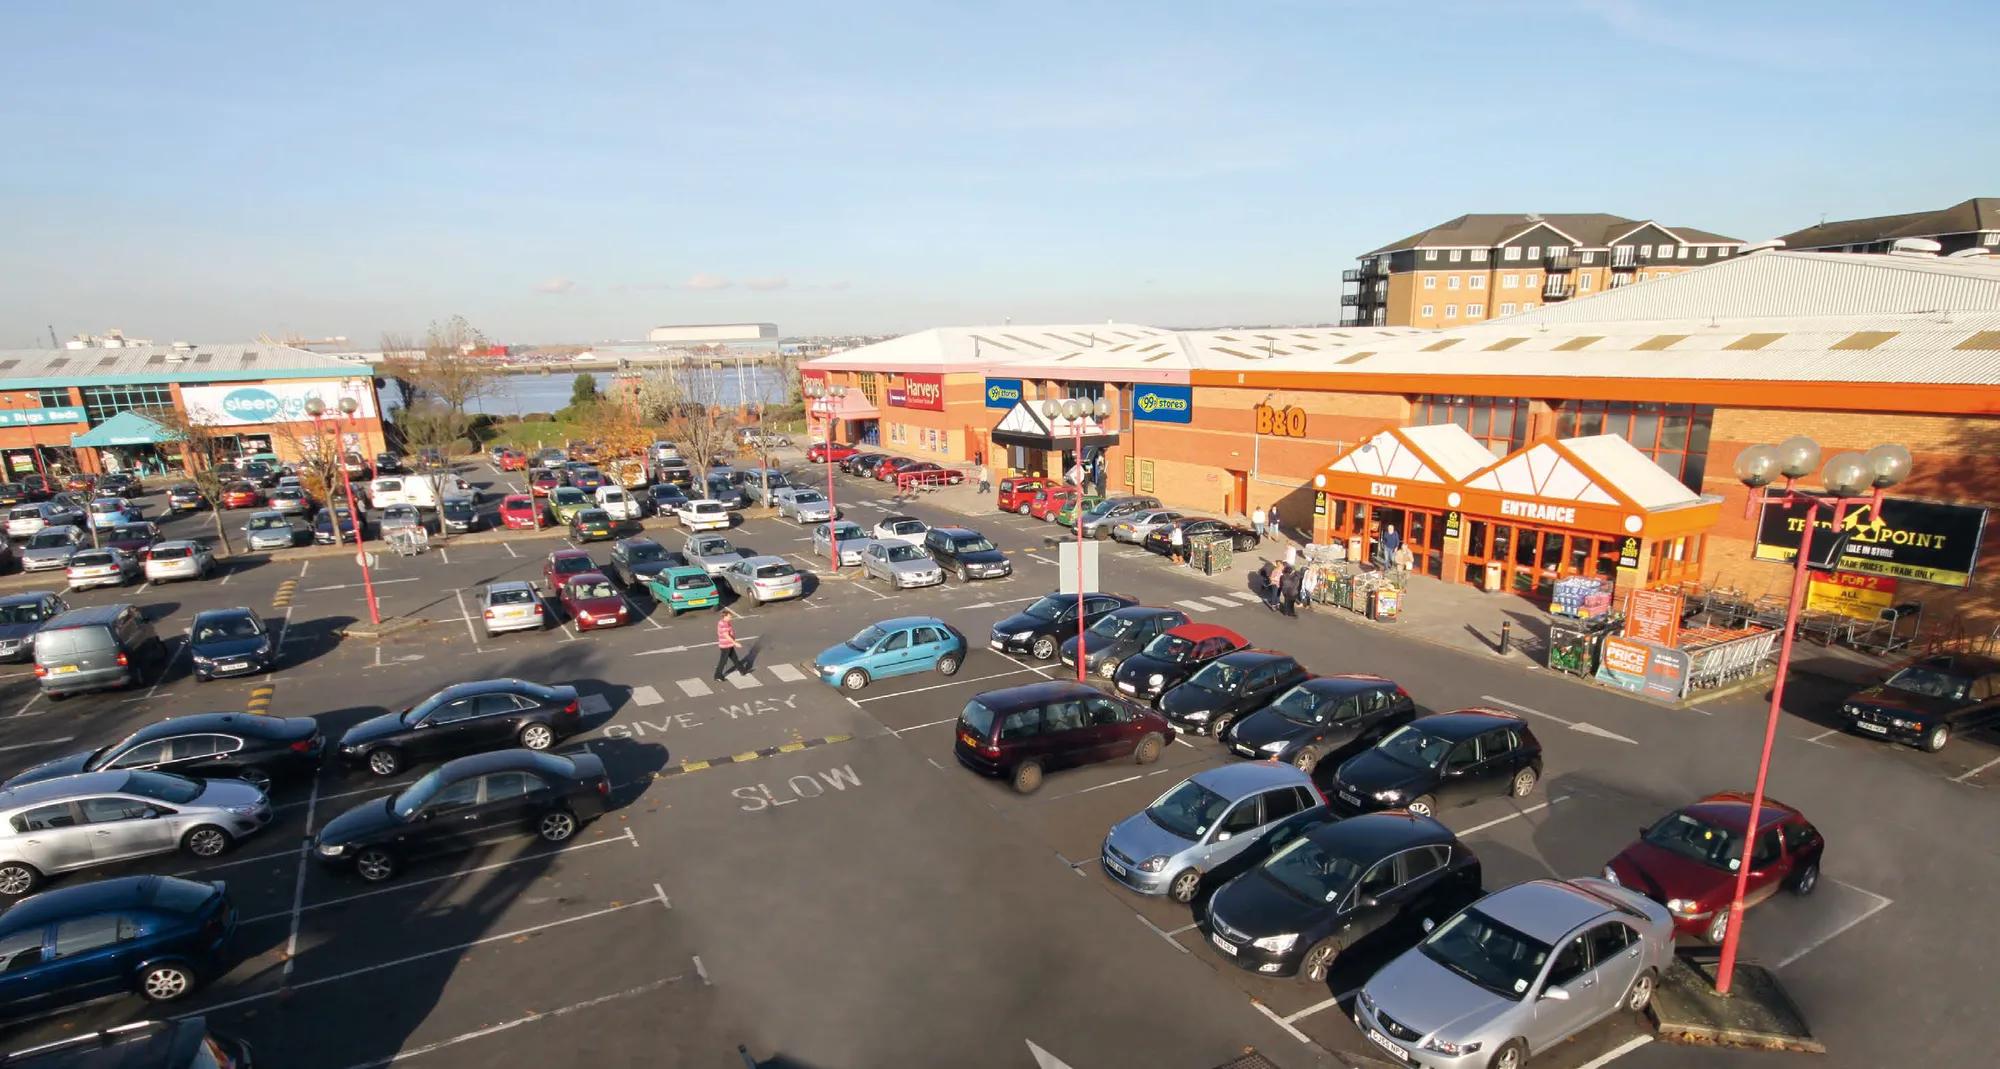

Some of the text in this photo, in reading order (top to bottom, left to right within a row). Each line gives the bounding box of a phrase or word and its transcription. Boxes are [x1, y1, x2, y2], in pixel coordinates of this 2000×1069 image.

[906, 378, 940, 404] Harveys
[1159, 400, 1184, 409] stores
[1256, 405, 1307, 437] B&Q
[1371, 482, 1398, 498] EXIT
[1501, 499, 1576, 524] ENTRANCE
[1880, 529, 1947, 549] POINT
[1841, 574, 1865, 586] FOR
[1867, 576, 1879, 588] 2
[1606, 646, 1646, 667] PRICE
[603, 694, 797, 740] GIVE WAY
[731, 764, 864, 812] SLOW
